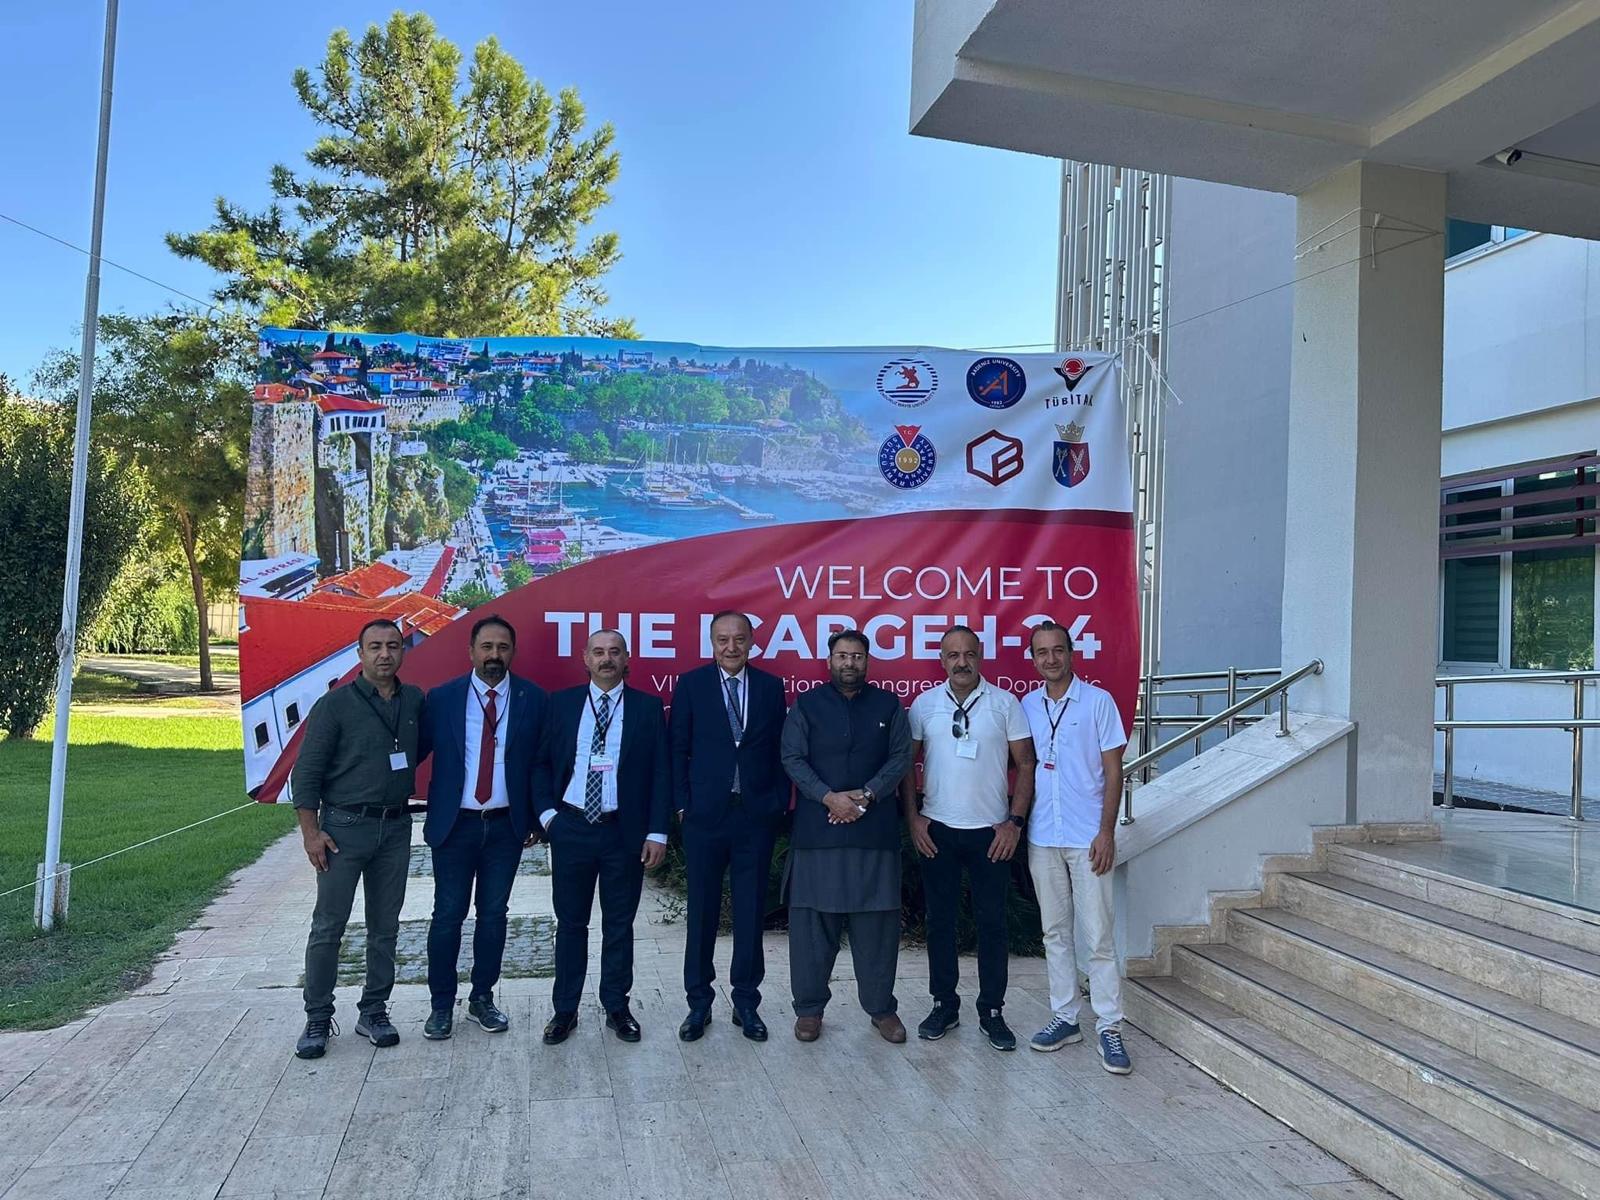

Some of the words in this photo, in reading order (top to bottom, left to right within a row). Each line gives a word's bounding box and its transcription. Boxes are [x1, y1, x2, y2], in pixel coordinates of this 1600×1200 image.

[774, 565, 1024, 600] WELCOME
[1035, 566, 1098, 600] TO
[544, 611, 676, 659] THE
